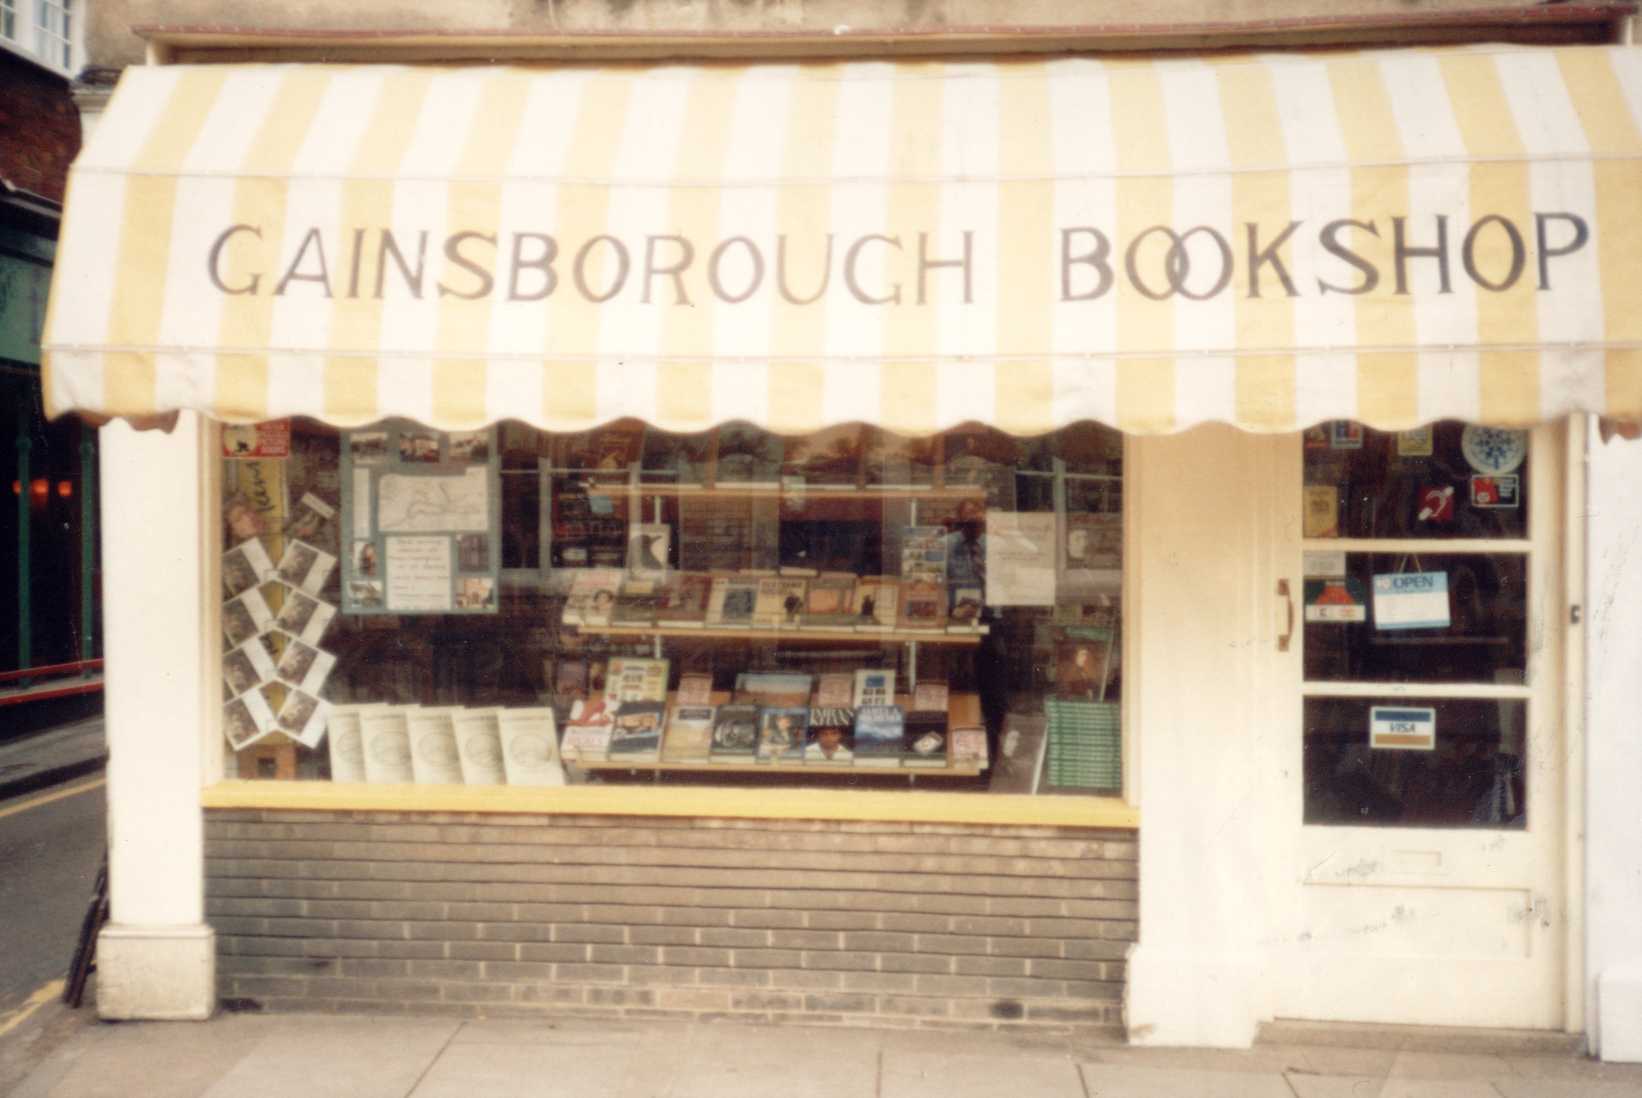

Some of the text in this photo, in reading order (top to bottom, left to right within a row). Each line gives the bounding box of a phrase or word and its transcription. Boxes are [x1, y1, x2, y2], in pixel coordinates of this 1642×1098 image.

[207, 211, 1590, 306] GAINSBOROUGH BOOKSHOP
[1392, 575, 1434, 589] OPEN
[1389, 722, 1416, 733] VISA
